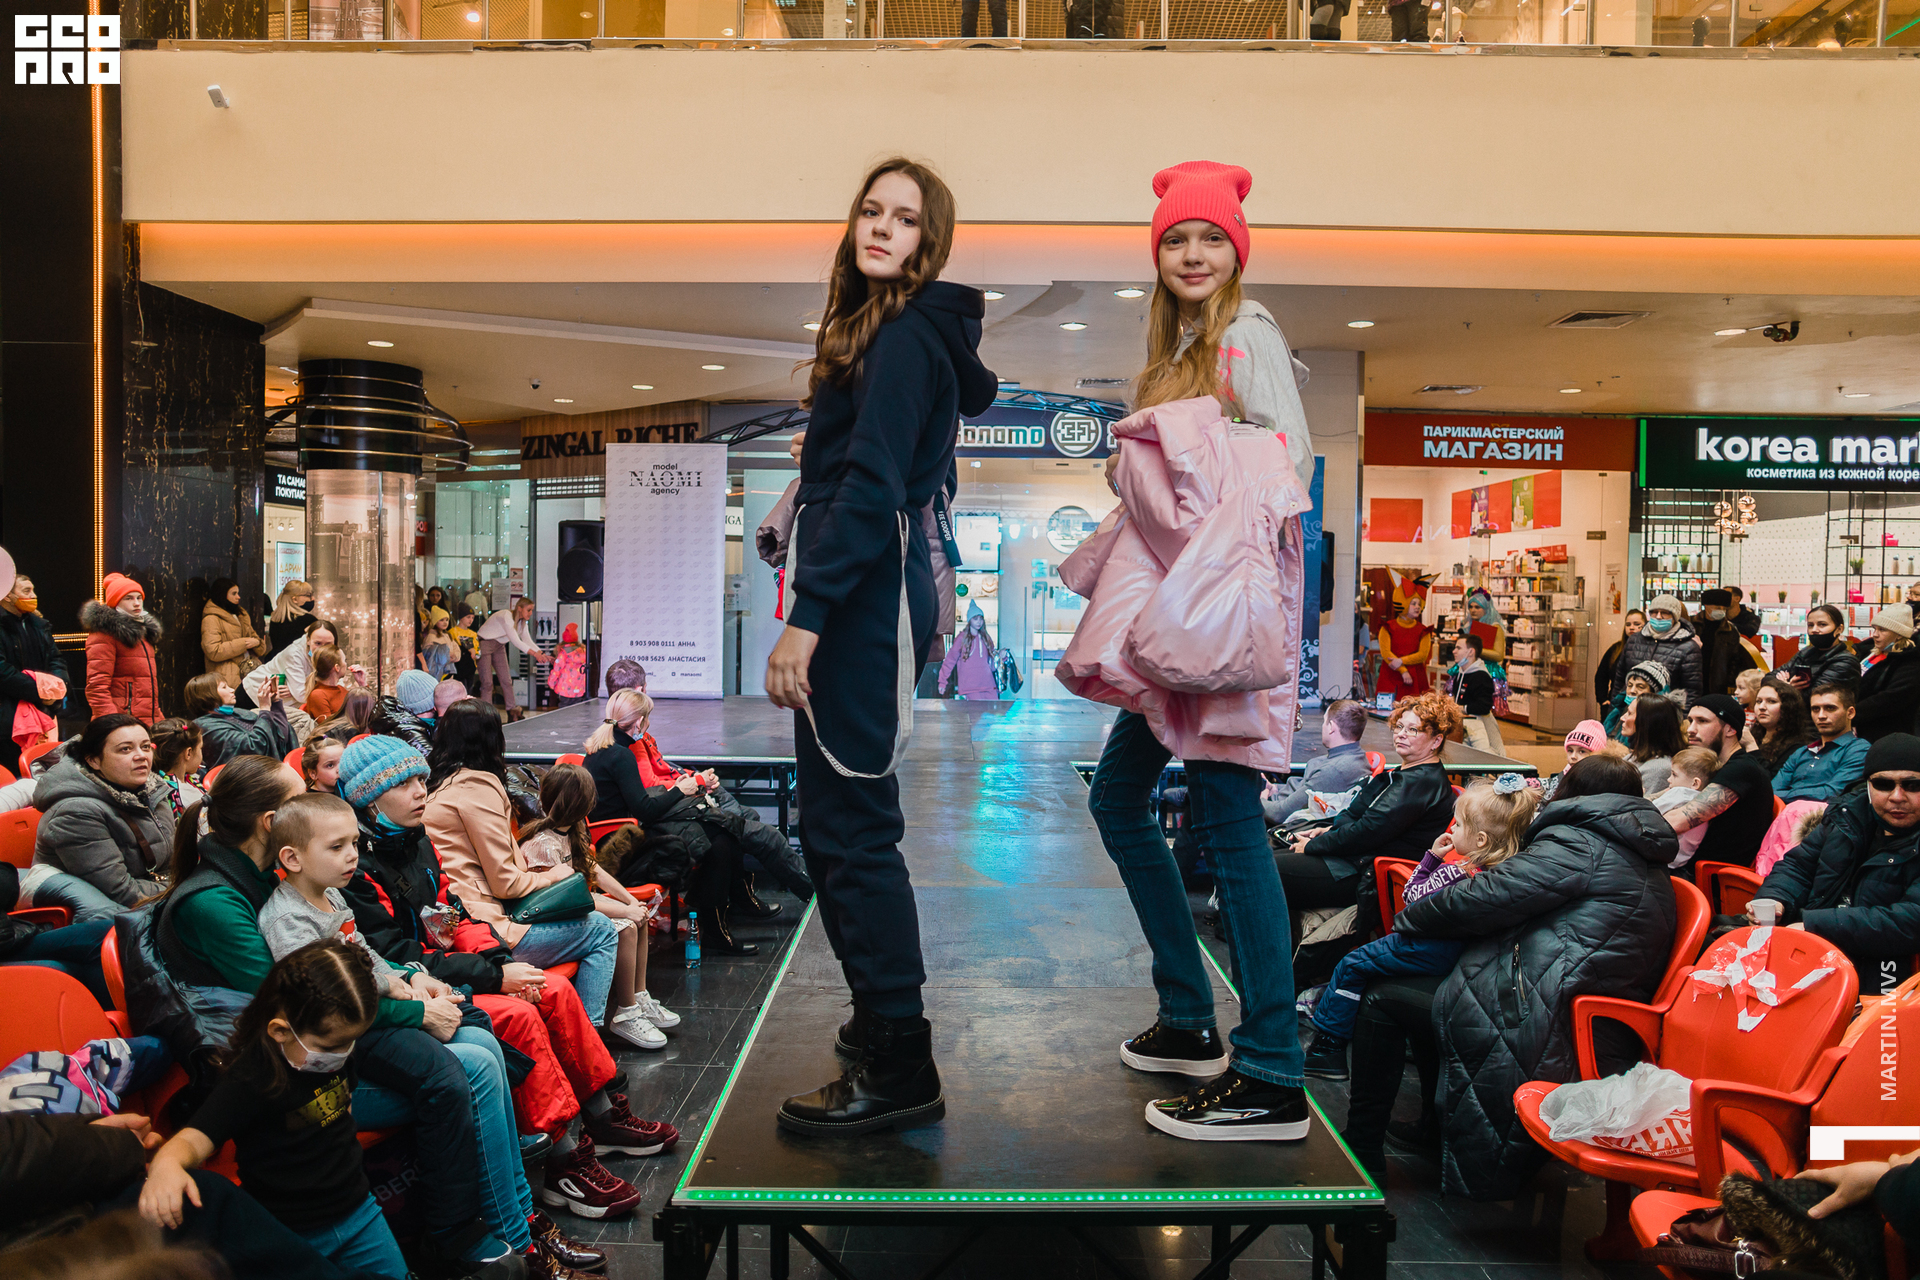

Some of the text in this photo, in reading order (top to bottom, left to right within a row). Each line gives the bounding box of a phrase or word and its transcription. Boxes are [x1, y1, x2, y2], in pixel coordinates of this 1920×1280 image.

[1423, 425, 1565, 440] ПАРИКМАСТЕРСКИЙ
[521, 430, 606, 461] ZINGAL
[1423, 440, 1564, 461] МАГАЗИН
[1696, 427, 1920, 465] korea mar
[277, 473, 286, 485] ТА
[629, 470, 703, 488] NAOMI
[1746, 467, 1816, 479] косметика
[1819, 468, 1835, 479] из
[1837, 467, 1885, 480] южной
[650, 487, 680, 496] agency
[940, 520, 952, 542] COOPER
[313, 1075, 340, 1097] model
